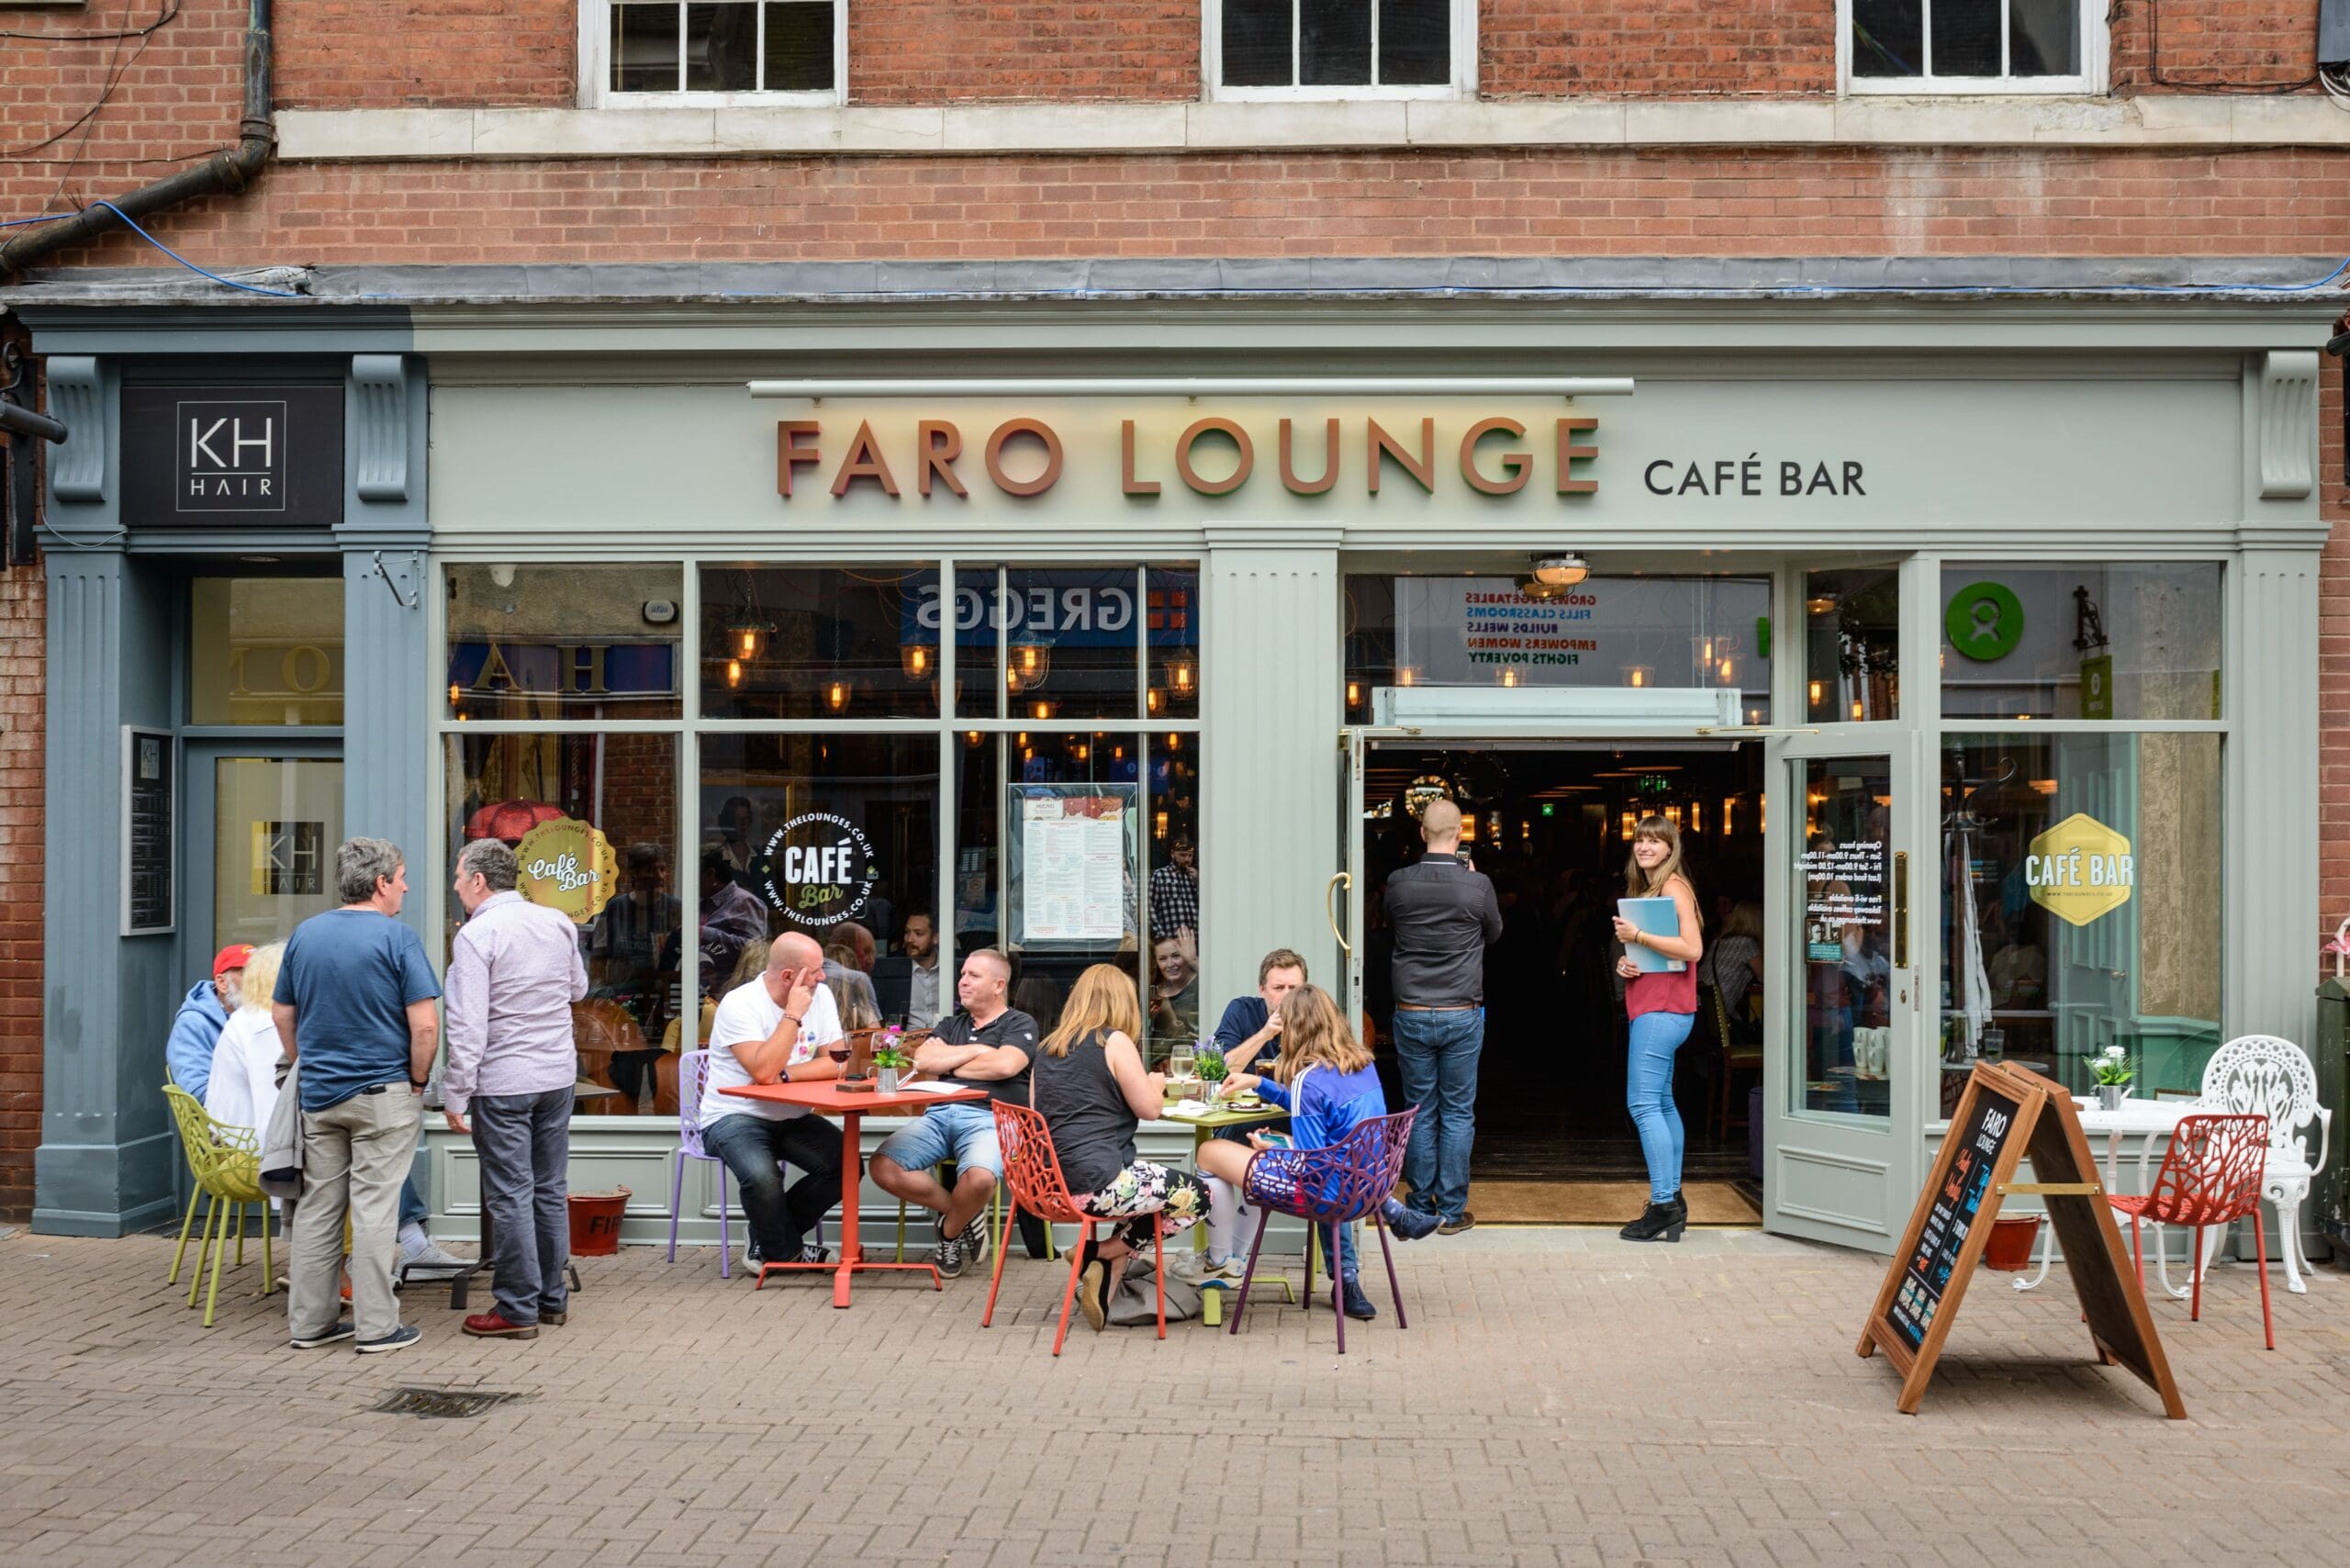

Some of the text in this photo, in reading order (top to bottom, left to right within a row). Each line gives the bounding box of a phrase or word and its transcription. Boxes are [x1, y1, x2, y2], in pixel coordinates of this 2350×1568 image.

[191, 417, 272, 468] KH
[777, 416, 1599, 498] FARO LOUNGE
[191, 478, 272, 496] HAIR
[1644, 452, 1866, 497] CAFÉ BAR
[764, 812, 874, 858] WWW.THELOUNGES.CO.UK
[527, 852, 578, 881] Café
[558, 868, 600, 891] Bar
[785, 836, 853, 884] CAFÉ
[2025, 846, 2133, 886] CAFÉ BAR
[764, 879, 874, 926] WWW.THELOUNGES.CO.UK
[798, 883, 844, 909] Bar
[1981, 1107, 2008, 1138] FARO
[1975, 1132, 1998, 1156] LOUNGE
